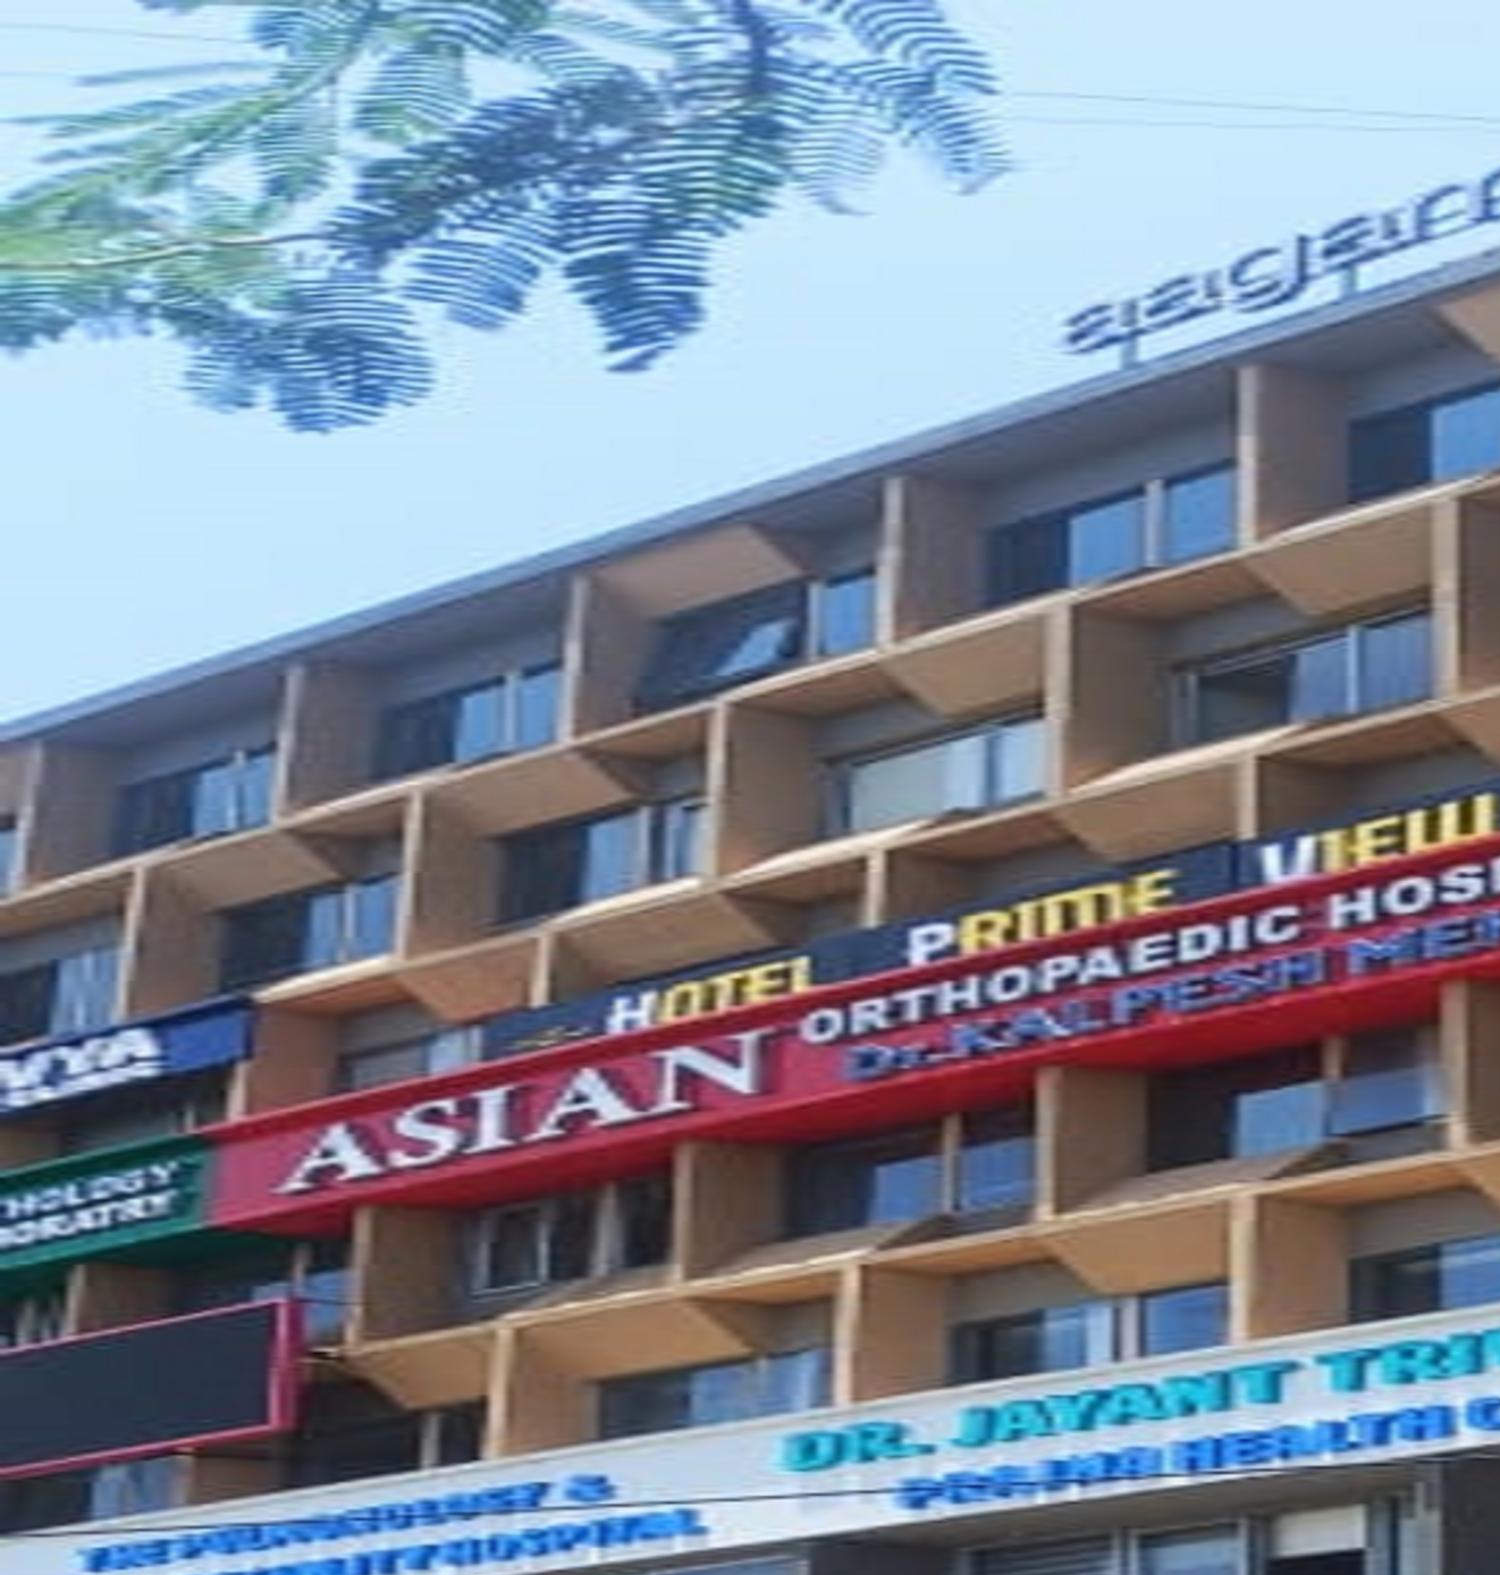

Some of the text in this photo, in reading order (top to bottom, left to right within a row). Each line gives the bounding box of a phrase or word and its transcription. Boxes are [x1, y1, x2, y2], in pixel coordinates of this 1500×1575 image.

[606, 793, 1499, 1036] HOTEL PRIME VIEW
[801, 902, 1300, 1045] ORTHOPAEDIC
[272, 1025, 782, 1195] ASIAN
[780, 1420, 936, 1473] DR.
[948, 1360, 1302, 1449] JAYANT
[1170, 1403, 1458, 1474] HEALTH
[441, 1508, 708, 1570] HOSPITAL
